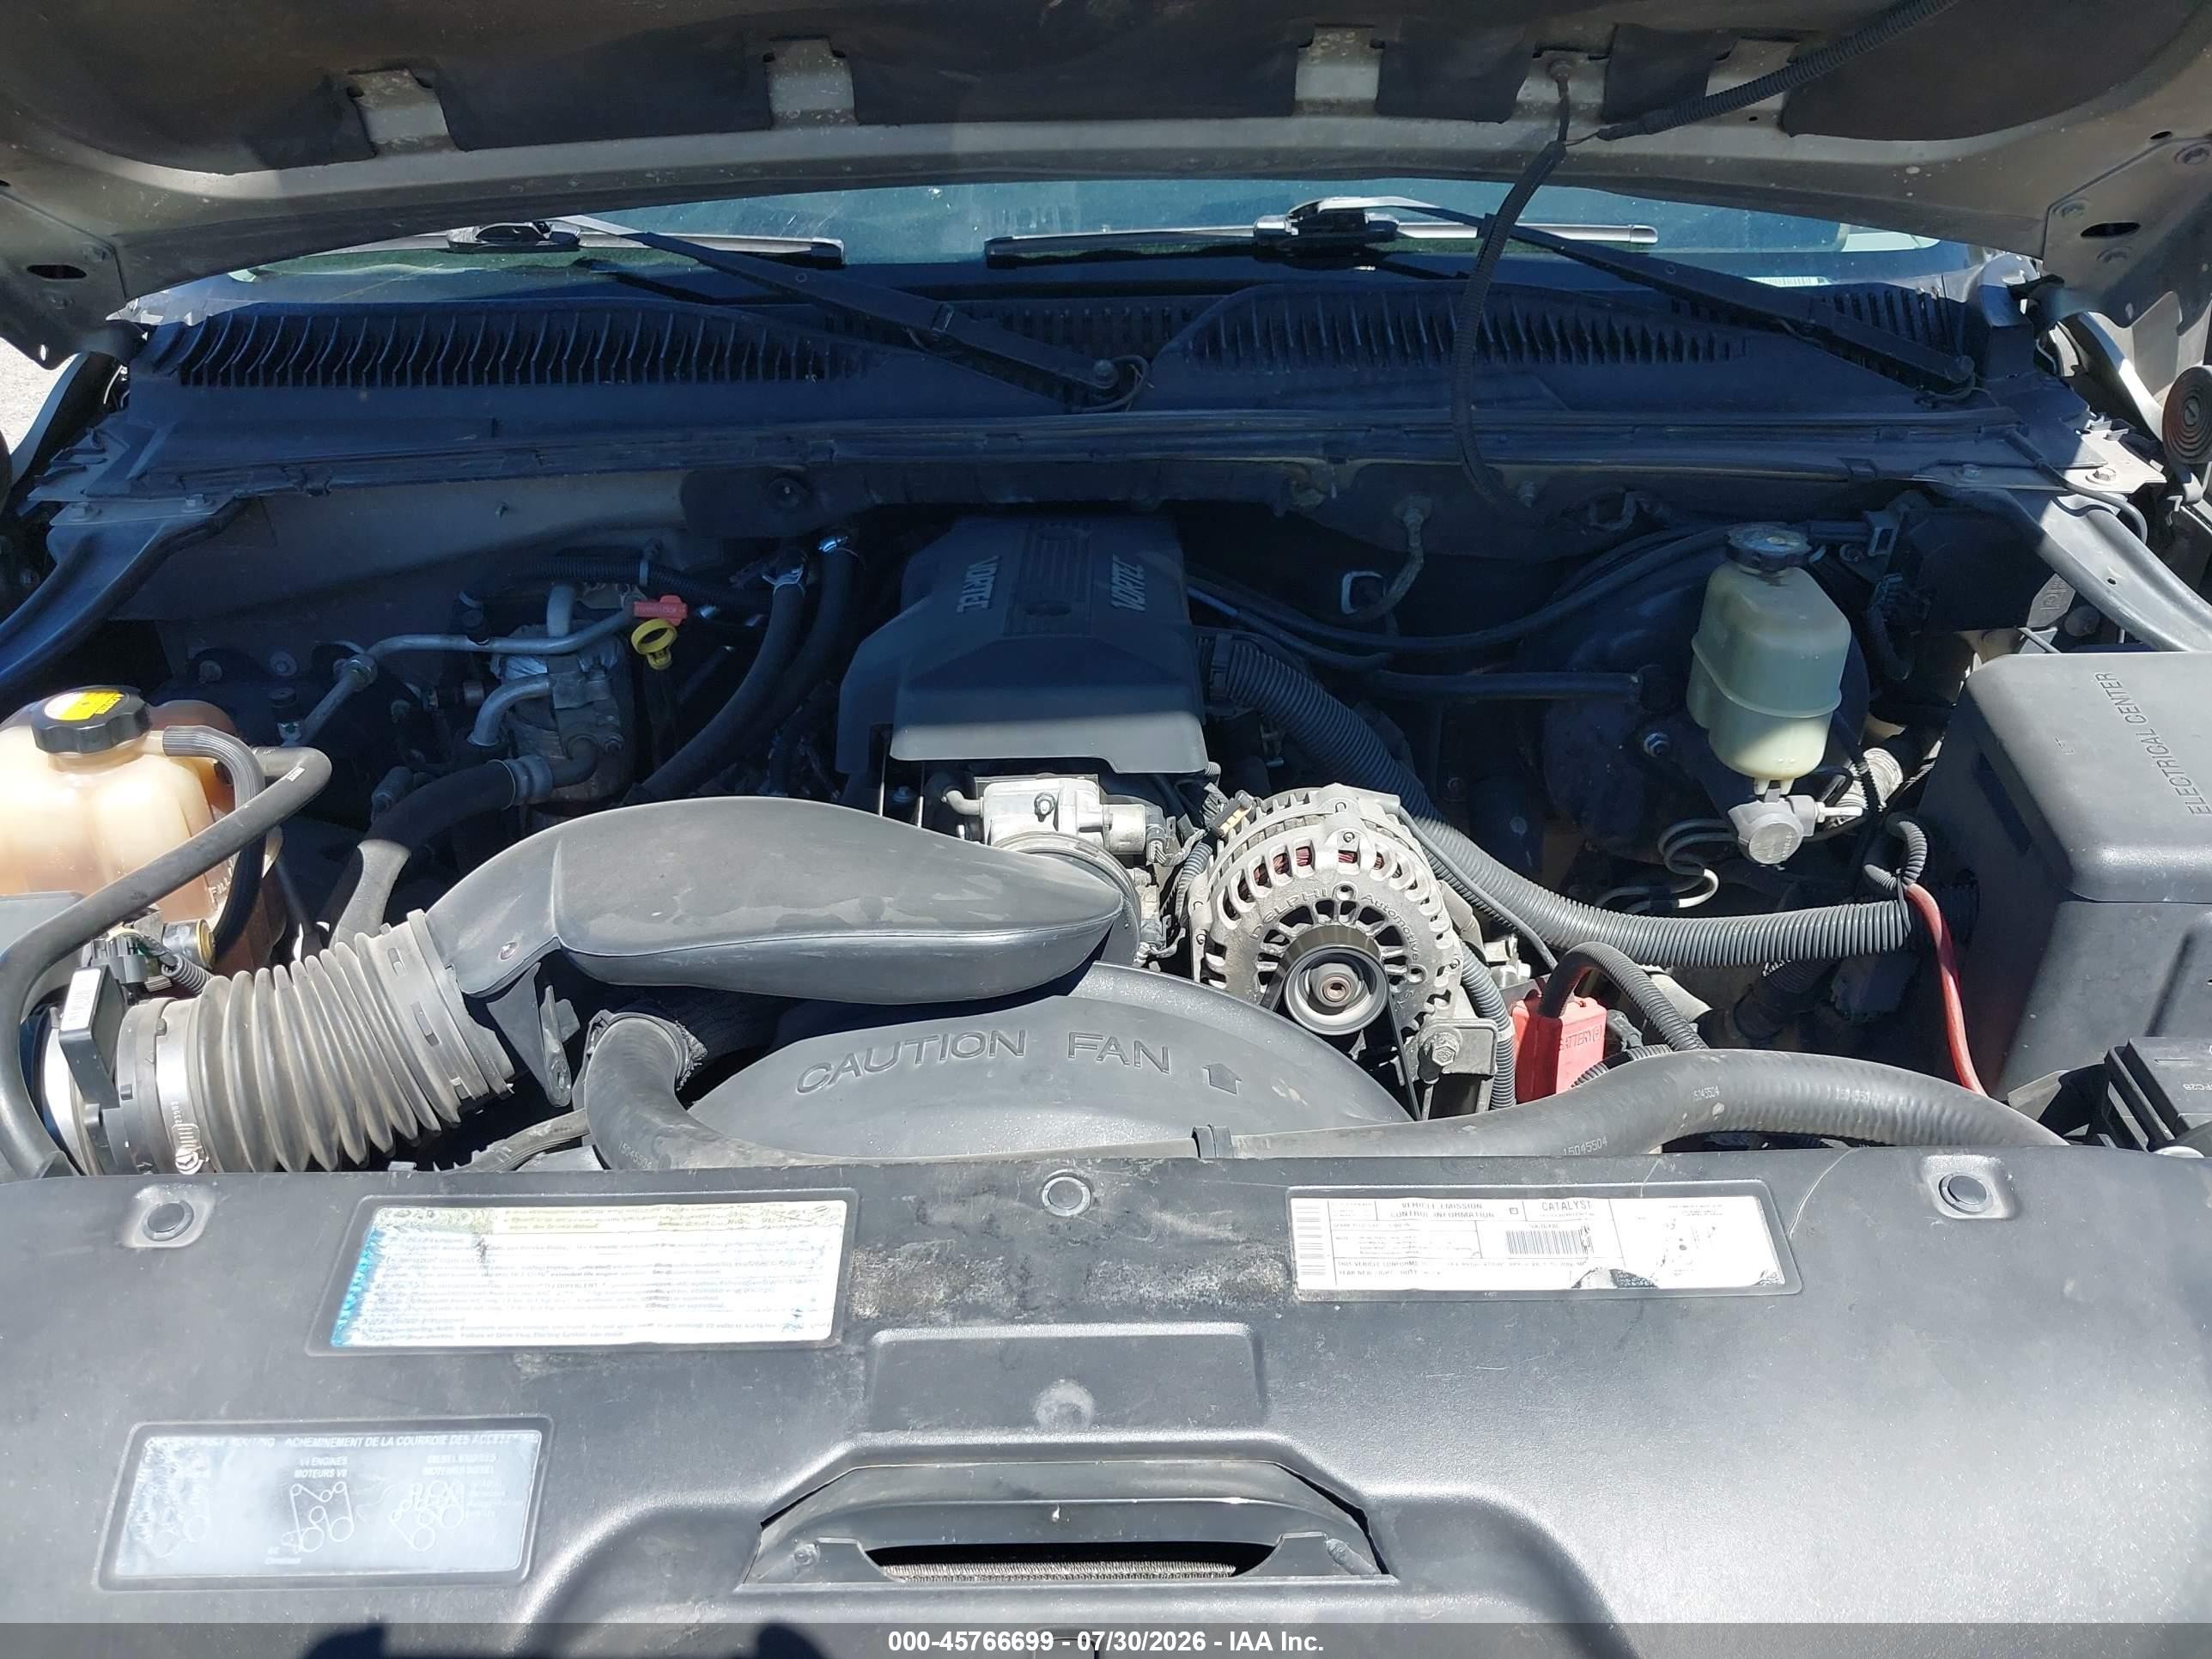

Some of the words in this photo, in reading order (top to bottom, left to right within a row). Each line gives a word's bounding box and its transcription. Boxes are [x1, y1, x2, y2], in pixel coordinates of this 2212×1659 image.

[956, 555, 1002, 614] VORTEC
[1111, 554, 1148, 612] VORTEC
[2094, 671, 2150, 726] CENTER
[2135, 727, 2212, 816] ELECTRICAL
[1249, 886, 1328, 940] DELPHI
[1360, 893, 1420, 962] Automotive
[796, 1029, 1028, 1095] CAUTION
[1066, 1030, 1171, 1076] FAN
[1390, 1210, 1429, 1218] CONTROL
[1433, 1210, 1495, 1218] INFORMATION
[1401, 1201, 1436, 1210] VEHICLE
[1439, 1201, 1483, 1210] EMISSION
[1539, 1200, 1593, 1212] CATALYST
[284, 1437, 362, 1448] ACHEMINEMENT
[364, 1436, 380, 1448] DE
[380, 1436, 394, 1447] LA
[449, 1435, 471, 1445] DES
[294, 1468, 335, 1479] MOTEURS
[311, 1455, 349, 1466] ENGINES
